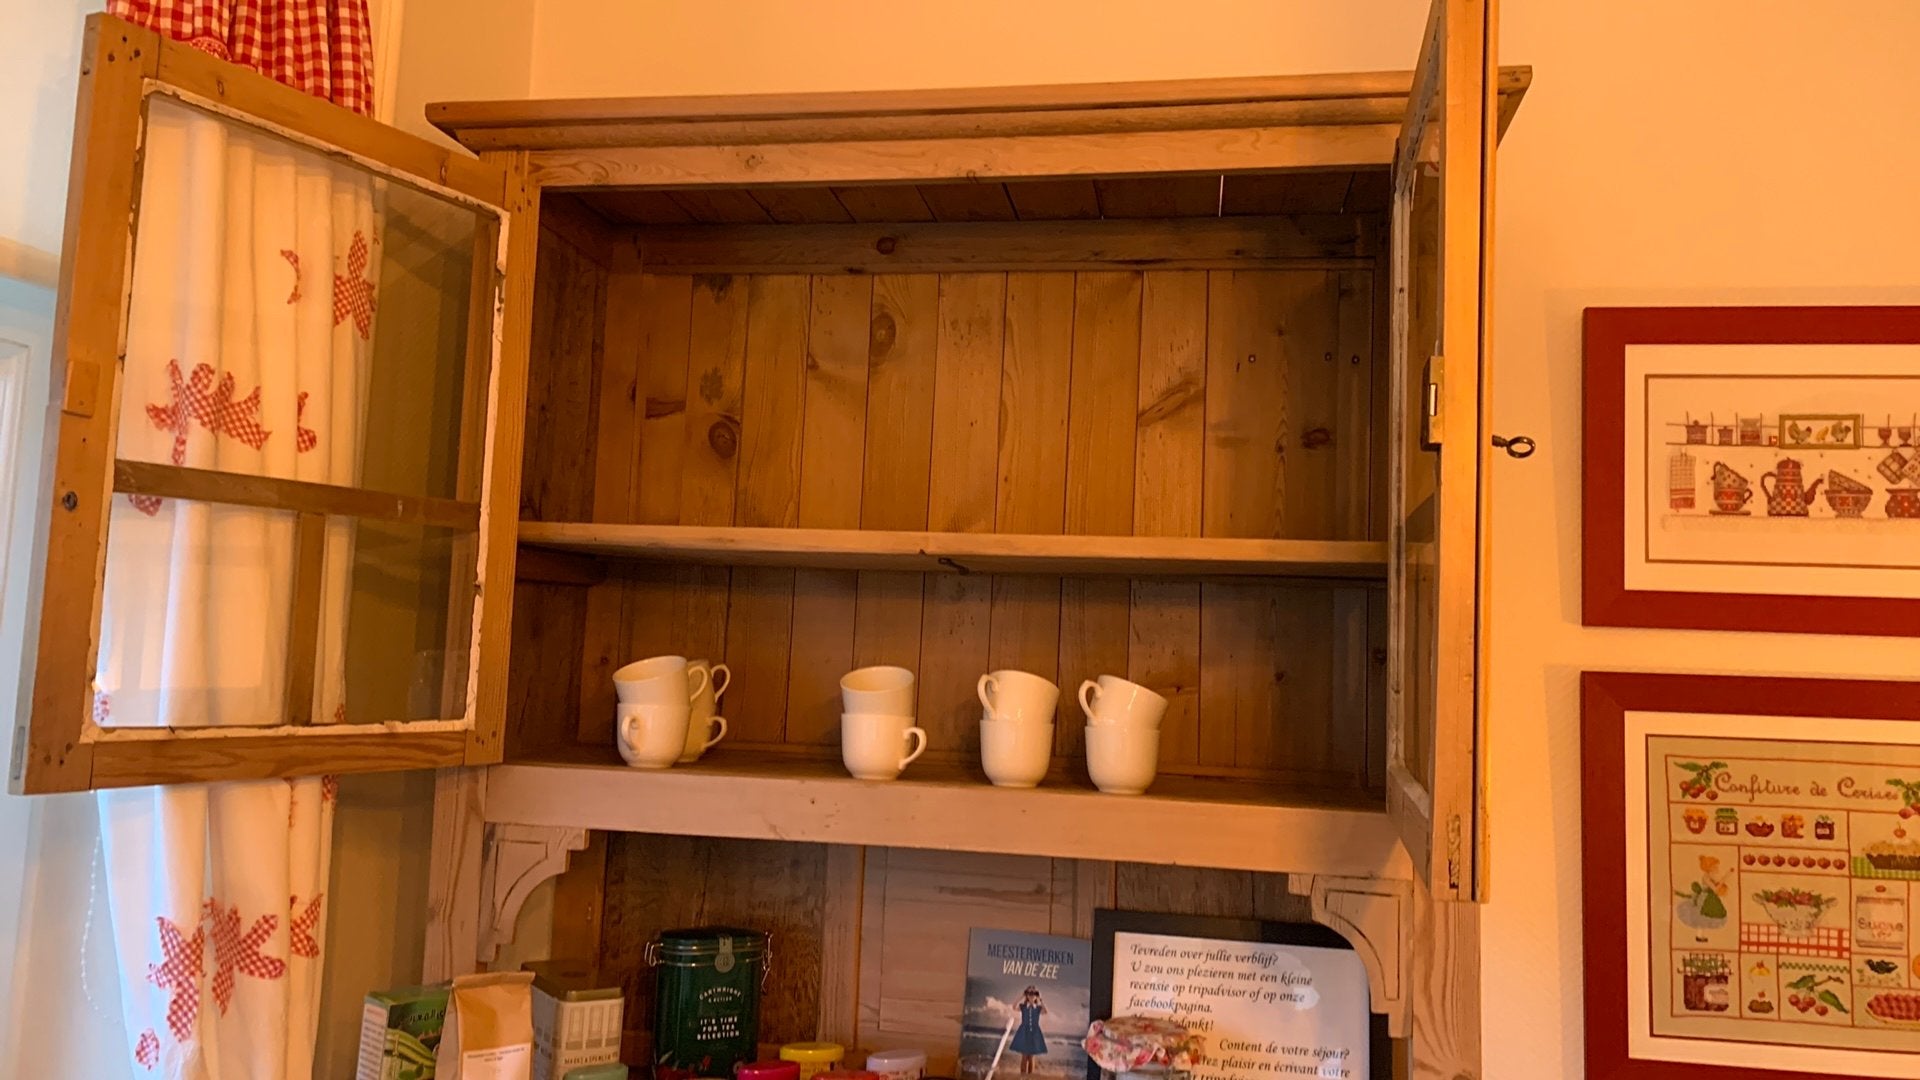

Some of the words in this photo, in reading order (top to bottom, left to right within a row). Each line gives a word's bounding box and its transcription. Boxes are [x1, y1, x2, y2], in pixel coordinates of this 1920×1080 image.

[1714, 771, 1801, 802] Confiture
[1810, 780, 1828, 797] de
[1837, 776, 1899, 800] Cerises
[987, 943, 1074, 965] MEESTERWERKEN
[1130, 943, 1177, 958] Tevreden
[1180, 949, 1203, 960] over
[1202, 948, 1232, 964] jullie
[1235, 950, 1279, 969] verblijf?
[1002, 960, 1023, 976] VAN
[1025, 962, 1038, 977] DE
[1040, 963, 1060, 980] ZEE
[1130, 960, 1142, 972] U
[1144, 964, 1163, 974] zou
[1166, 966, 1184, 976] ons
[1187, 964, 1234, 980] plezieren
[1237, 971, 1256, 981] met
[1260, 973, 1278, 983] een
[1281, 970, 1313, 987] kleine
[1130, 980, 1170, 992] recensie
[1172, 984, 1186, 996] op
[1188, 983, 1248, 998] tripadvisor
[1249, 986, 1263, 1002] of
[1263, 991, 1277, 1004] op
[1280, 991, 1305, 1002] onze
[1126, 994, 1213, 1015] facebookpagina.
[720, 1016, 738, 1024] TIME
[722, 1023, 735, 1031] TEA
[697, 1030, 740, 1041] SELECTION
[1220, 1038, 1262, 1052] Content
[1265, 1040, 1278, 1054] de
[1281, 1044, 1309, 1056] votre
[1312, 1046, 1350, 1062] séjour?
[1221, 1054, 1255, 1071] plaisir
[1258, 1061, 1271, 1072] en
[1274, 1060, 1318, 1075] écrivant
[1322, 1067, 1350, 1078] votre
